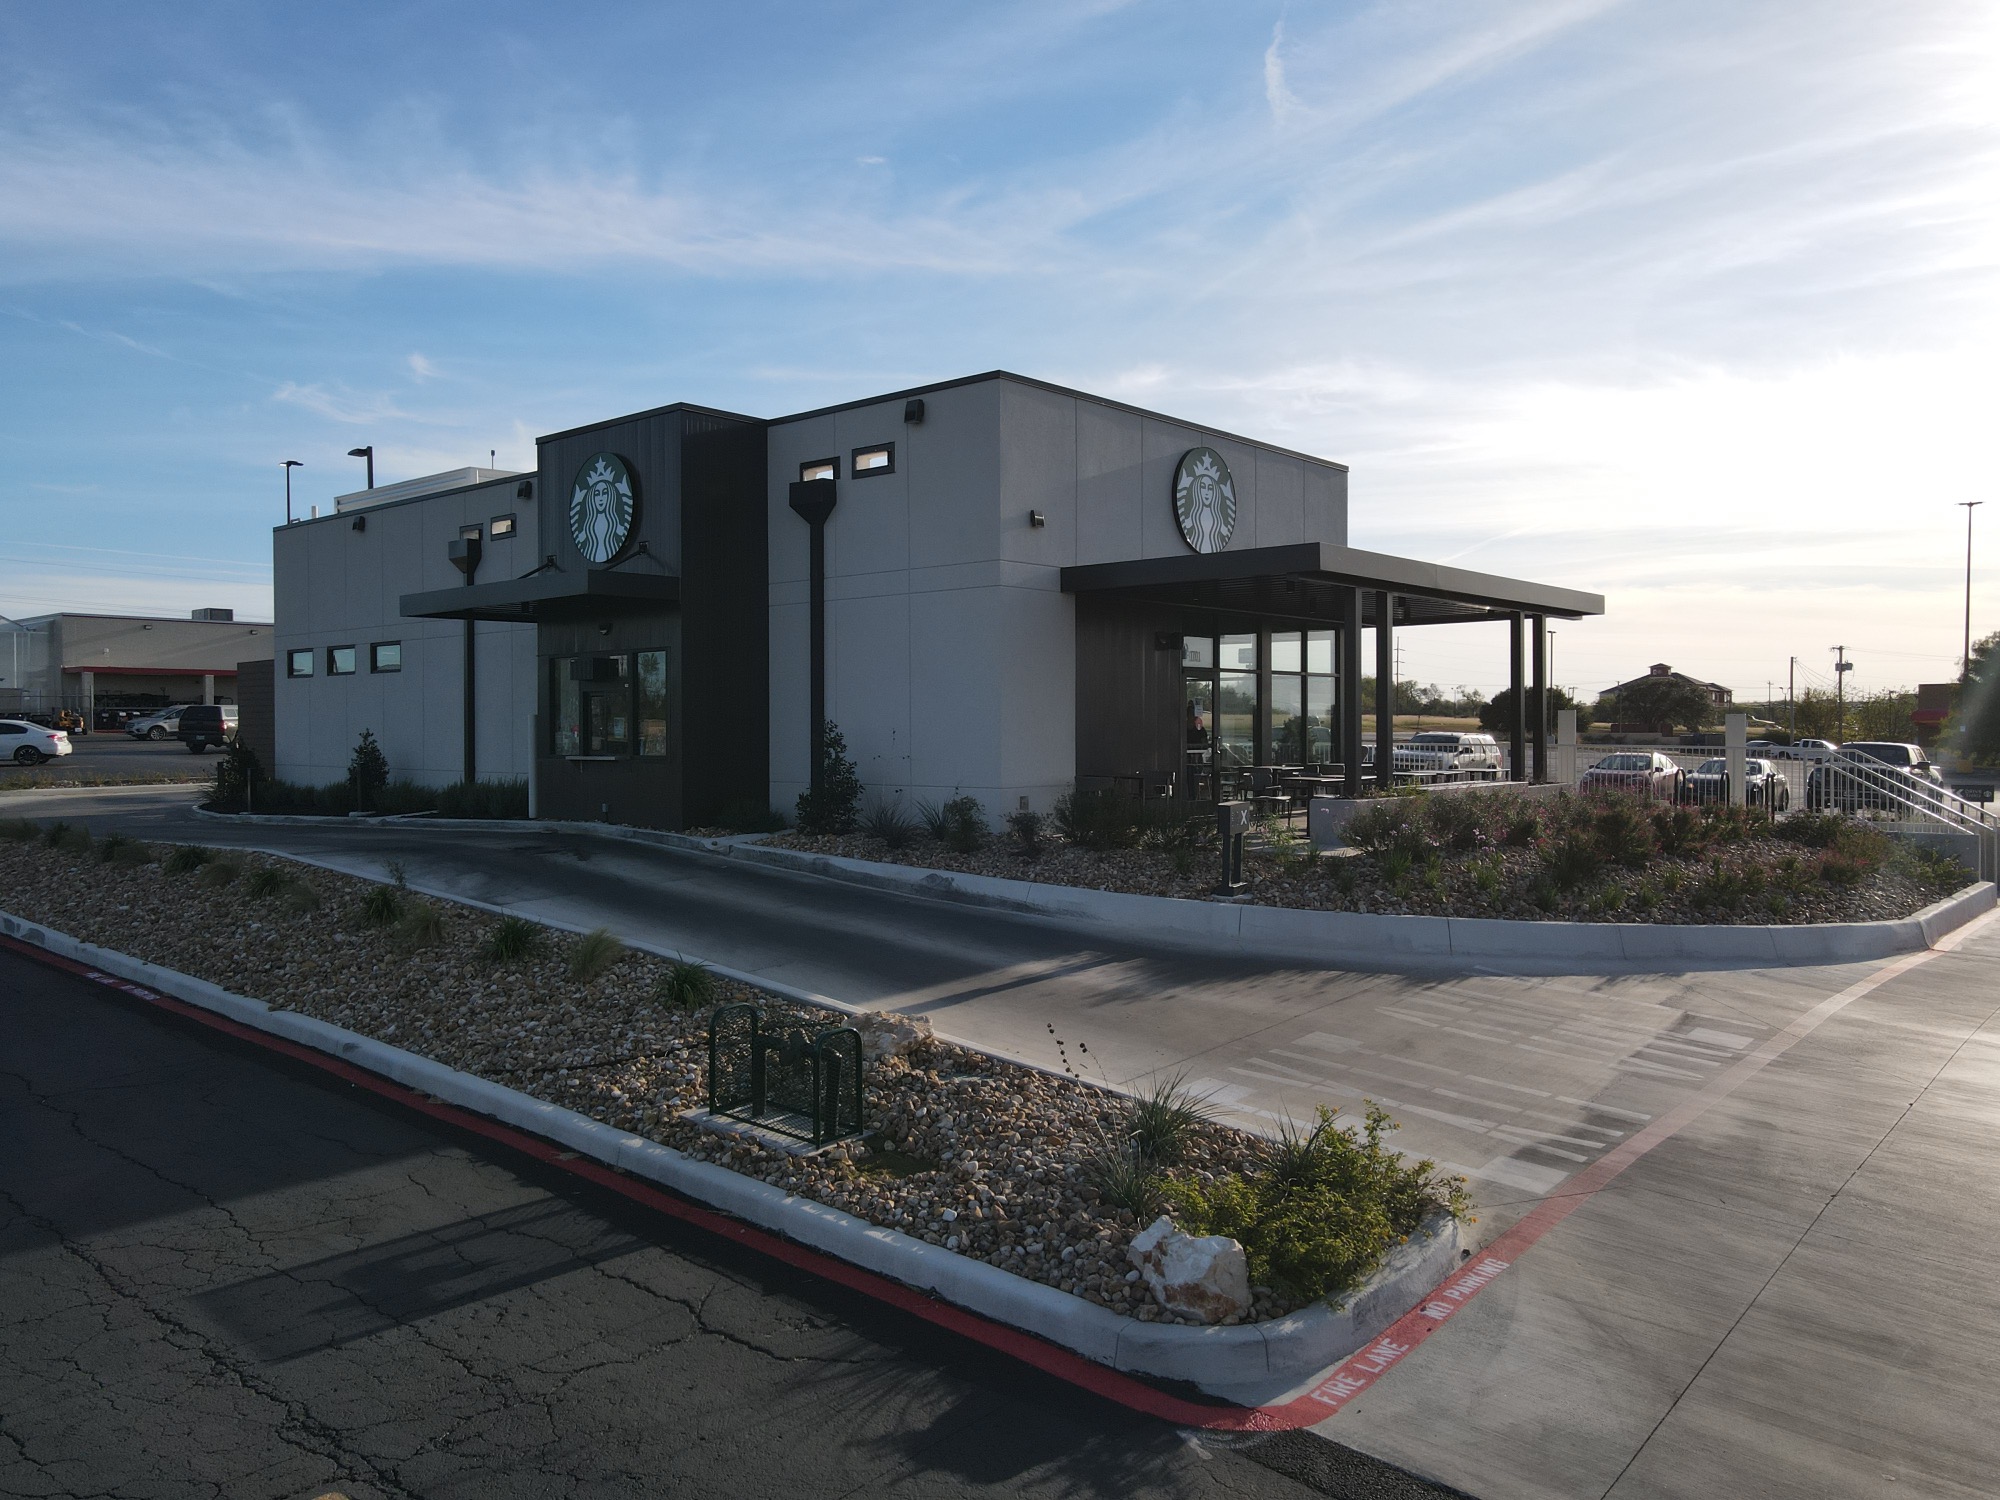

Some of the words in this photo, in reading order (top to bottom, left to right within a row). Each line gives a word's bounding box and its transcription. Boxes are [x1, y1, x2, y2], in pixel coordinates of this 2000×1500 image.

[1310, 1372, 1366, 1406] FIRE
[1353, 1338, 1409, 1374] LANE
[1419, 1301, 1454, 1320] NO
[1443, 1258, 1510, 1301] PARKING
